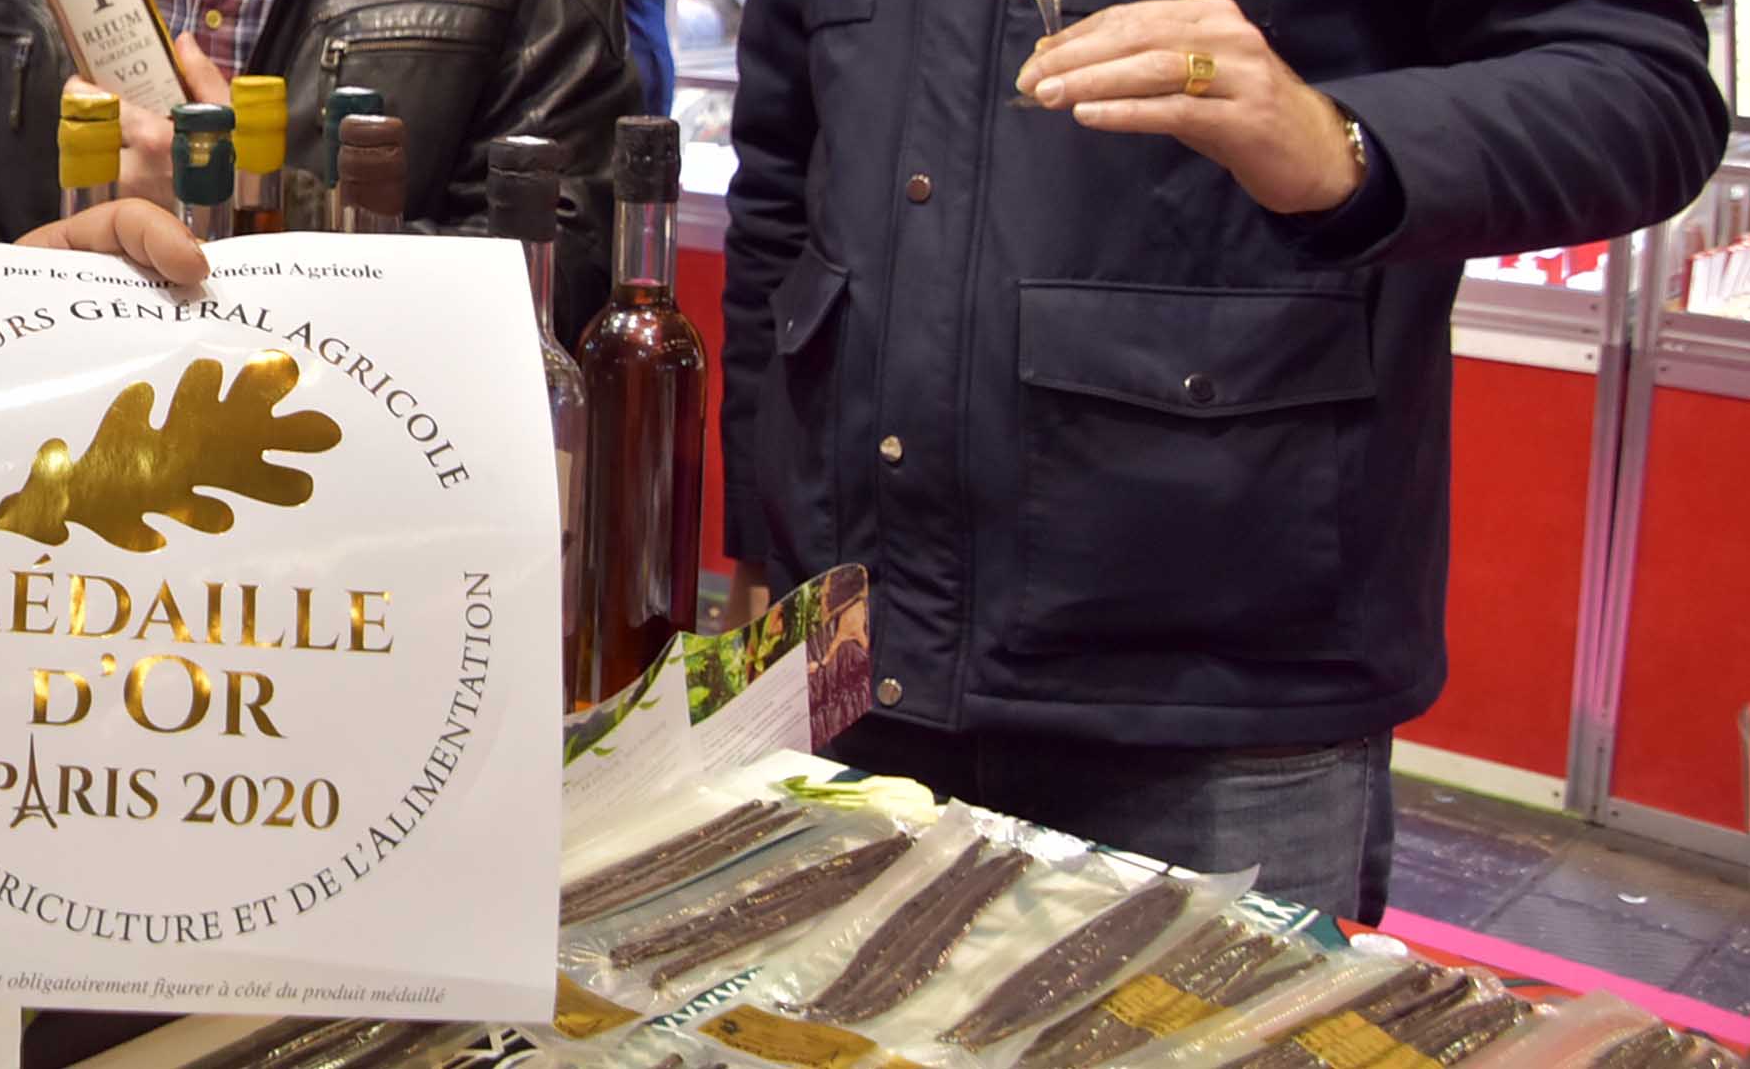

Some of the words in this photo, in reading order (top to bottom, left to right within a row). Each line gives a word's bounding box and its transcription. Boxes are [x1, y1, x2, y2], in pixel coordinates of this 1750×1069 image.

[82, 9, 143, 44] RHUM
[3, 266, 42, 277] par
[50, 268, 68, 279] le
[204, 262, 282, 279] énéral
[289, 262, 383, 280] Agricole
[70, 297, 273, 333] GÉNÉRAL
[283, 320, 470, 489] AGRICOLE
[232, 895, 278, 935] ET
[288, 867, 342, 916] DE
[341, 571, 493, 882] L'ALIMENTATION
[181, 771, 341, 830] 2020
[7, 971, 148, 995] obligatoirement
[151, 977, 214, 998] figurer
[218, 980, 229, 997] à
[234, 981, 271, 998] côté
[276, 981, 298, 999] du
[301, 982, 366, 1004] produit
[370, 984, 447, 1004] médaillé
